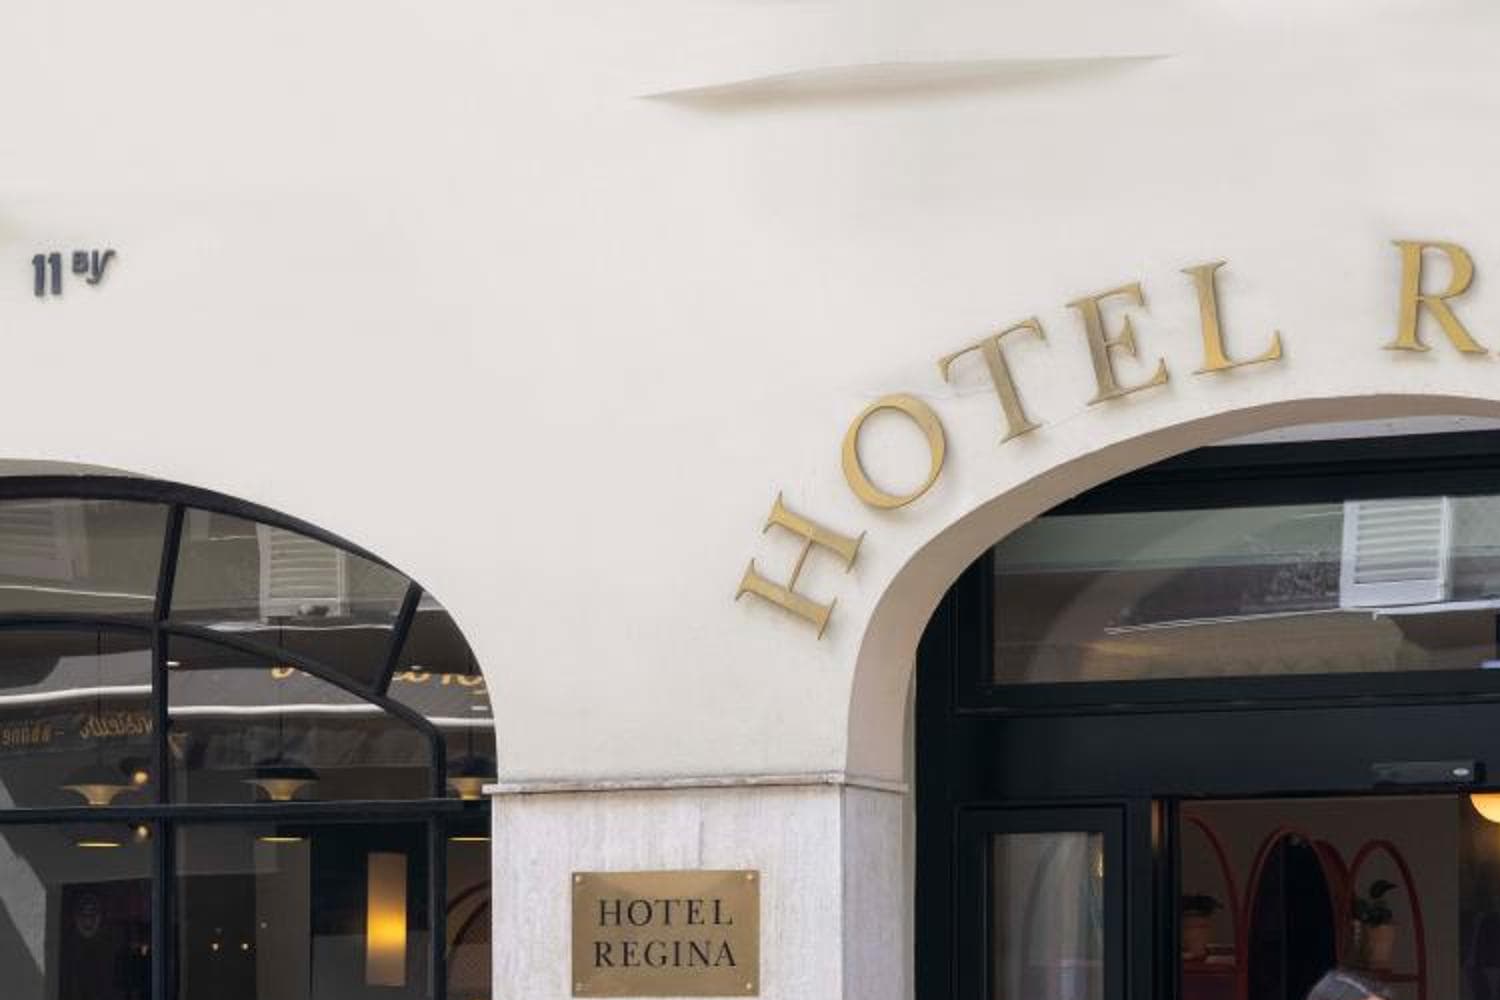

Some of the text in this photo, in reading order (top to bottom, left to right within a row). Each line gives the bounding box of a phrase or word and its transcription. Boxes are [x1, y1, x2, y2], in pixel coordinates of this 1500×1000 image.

[32, 252, 62, 297] 11
[735, 259, 1283, 641] HOTEL
[599, 898, 733, 927] HOTEL
[594, 940, 736, 968] REGINA
